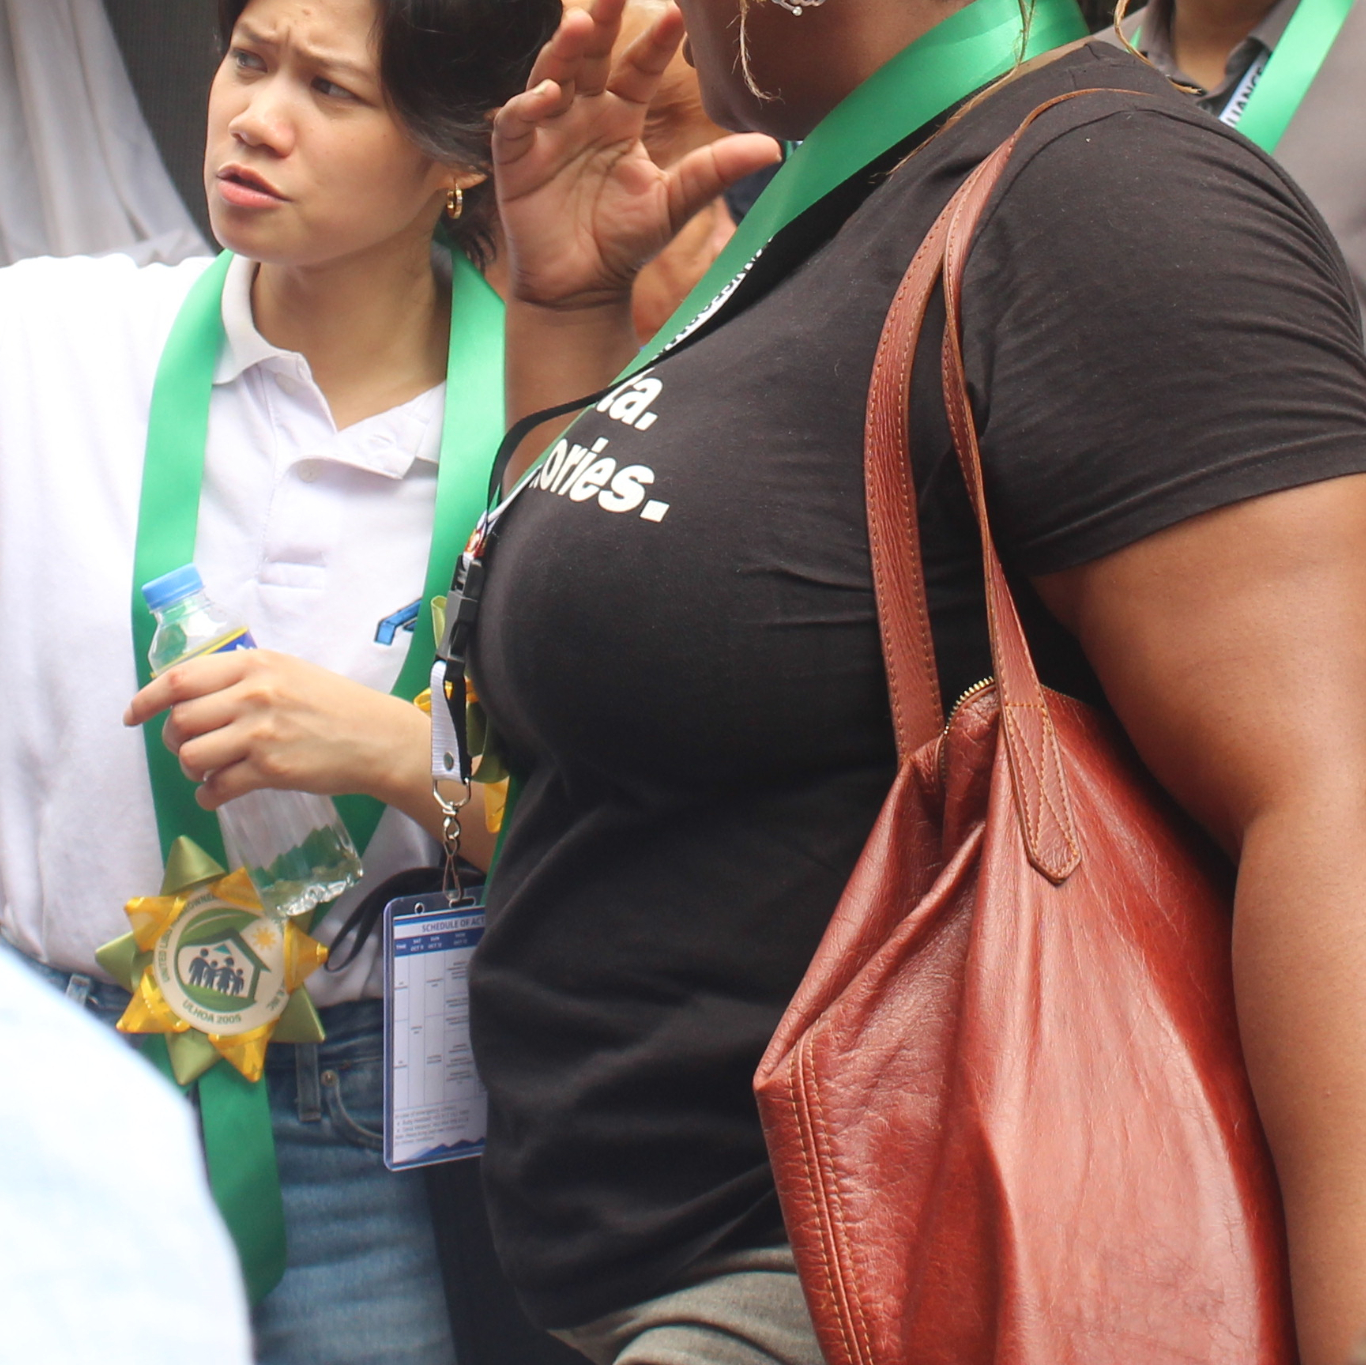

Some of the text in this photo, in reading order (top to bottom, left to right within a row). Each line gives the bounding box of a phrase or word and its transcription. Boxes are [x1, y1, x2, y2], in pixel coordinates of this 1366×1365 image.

[528, 437, 670, 523] ories.
[422, 920, 458, 933] SCHEDULE
[460, 918, 469, 928] OF
